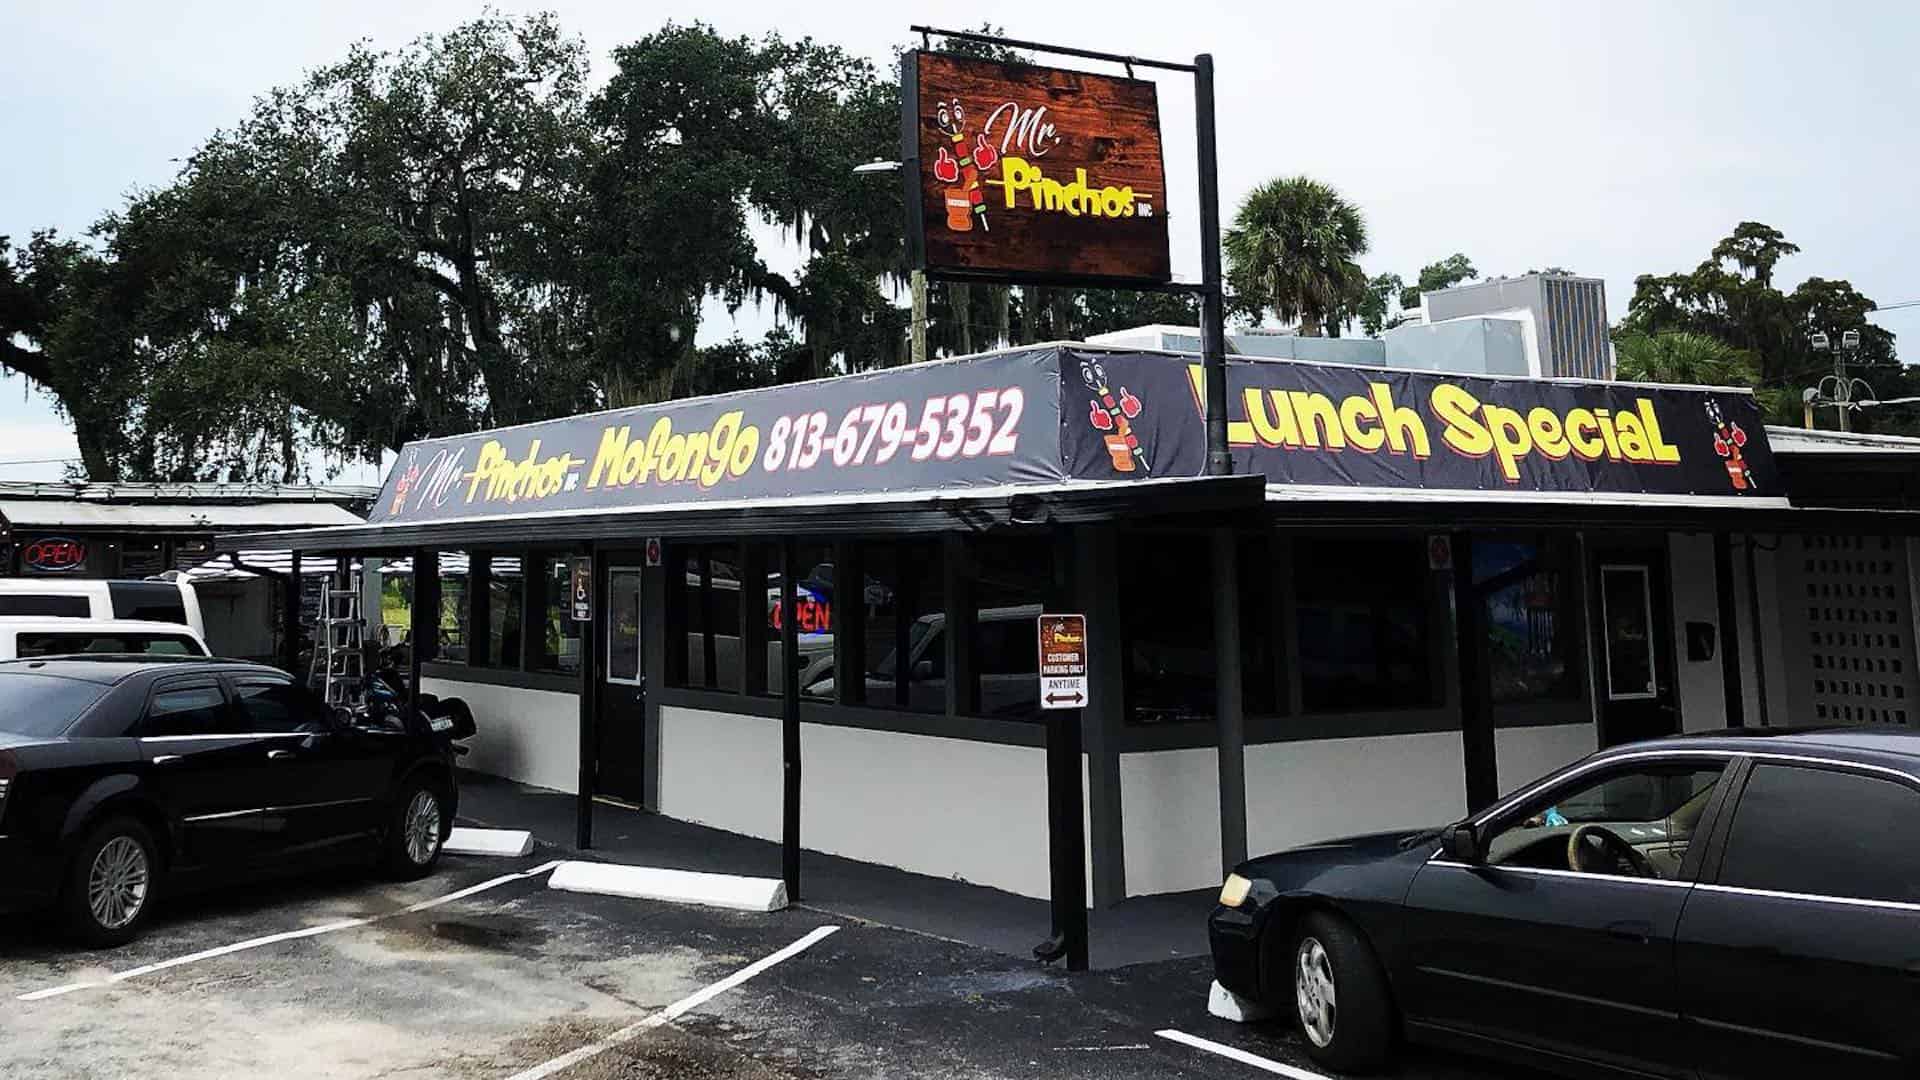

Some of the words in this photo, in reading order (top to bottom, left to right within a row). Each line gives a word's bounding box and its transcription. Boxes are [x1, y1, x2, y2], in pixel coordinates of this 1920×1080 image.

[984, 101, 1061, 156] Mr.
[1001, 156, 1136, 217] Pinchos
[415, 446, 463, 511] Mr.
[465, 439, 570, 503] Pinchos
[585, 410, 759, 491] Mofongo
[762, 385, 1025, 473] 813-679-5352
[24, 543, 86, 564] OPEN
[1047, 652, 1079, 663] CUSTOMER
[1043, 664, 1069, 674] PARKING
[1069, 664, 1084, 674] ONLY
[1048, 679, 1081, 689] ANYTIME
